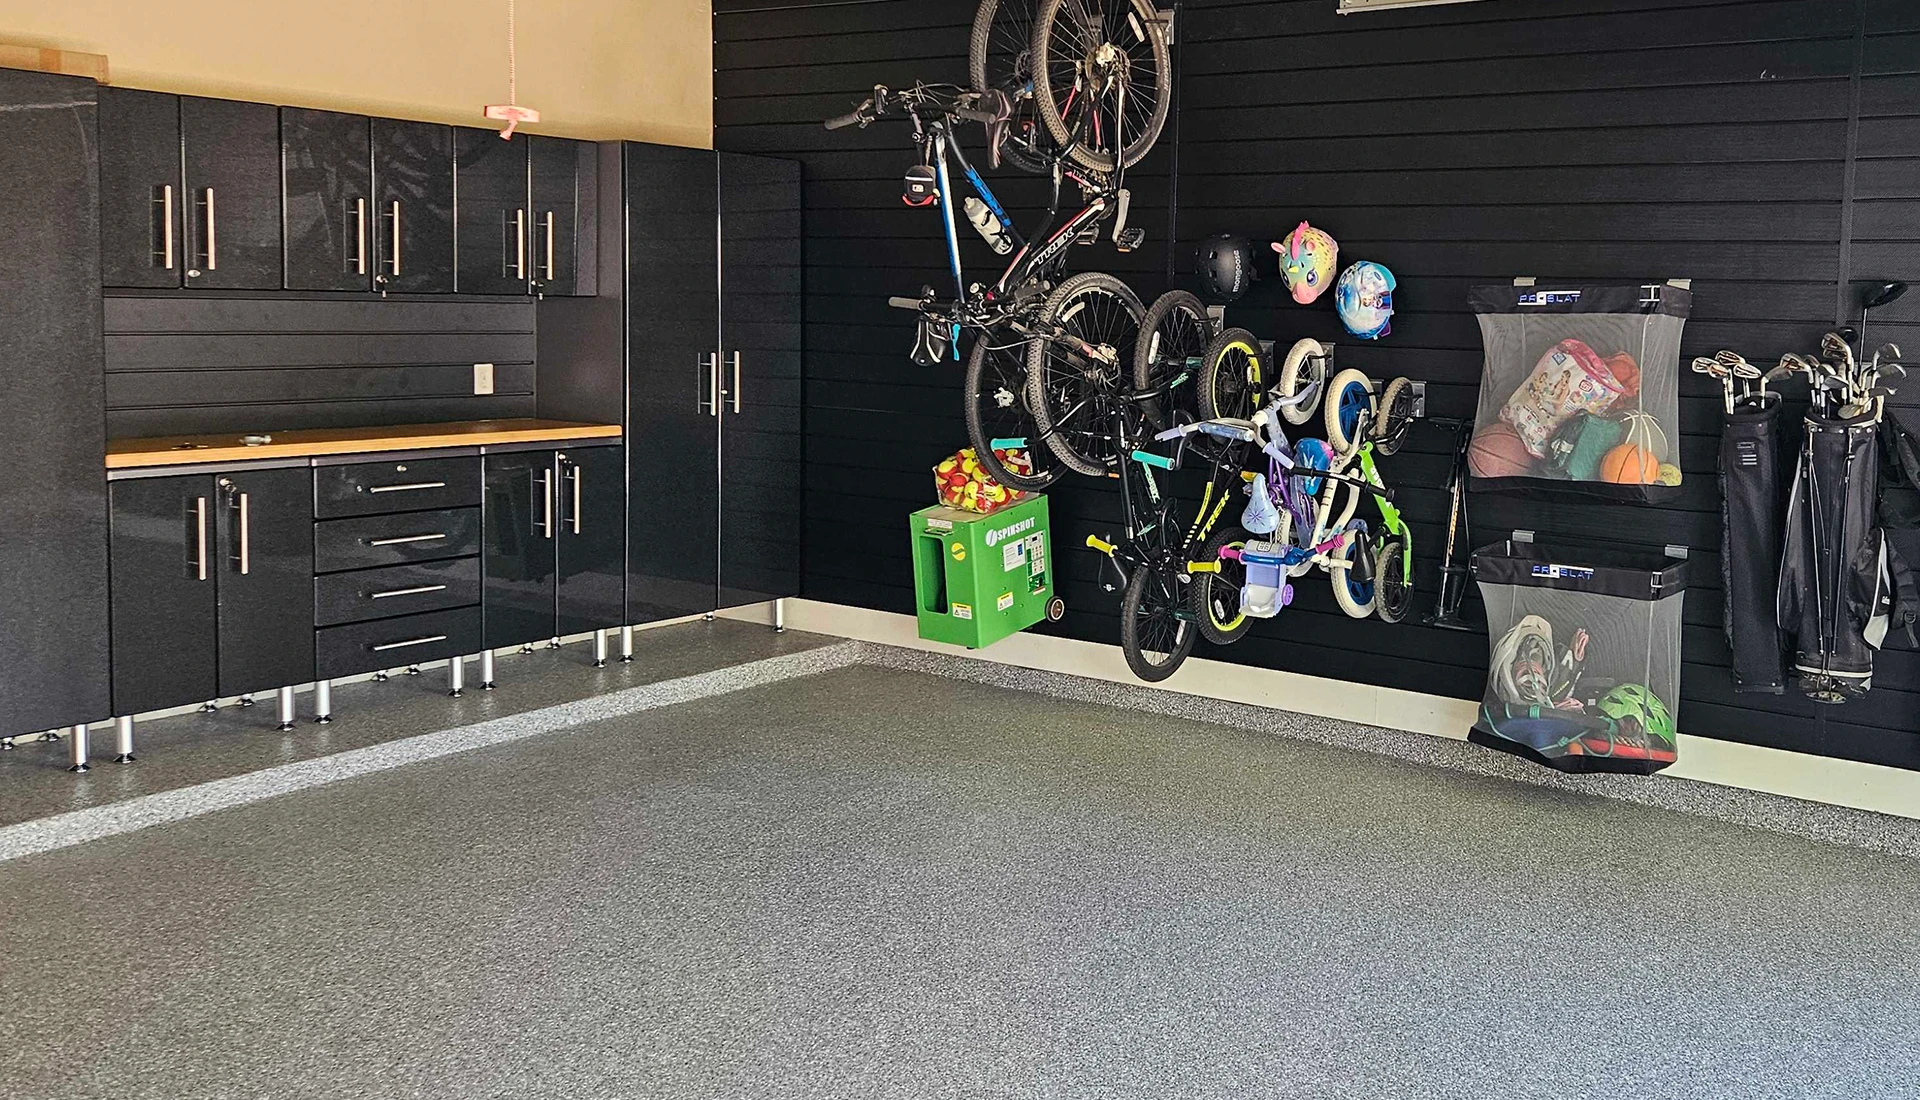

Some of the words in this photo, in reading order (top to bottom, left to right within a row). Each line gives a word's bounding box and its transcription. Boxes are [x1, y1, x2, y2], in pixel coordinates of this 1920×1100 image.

[1034, 226, 1075, 265] TREK
[1232, 249, 1243, 292] mongoose
[997, 517, 1036, 541] SPINSHOT
[1197, 488, 1230, 541] TREK
[1531, 564, 1594, 580] PROSLAT
